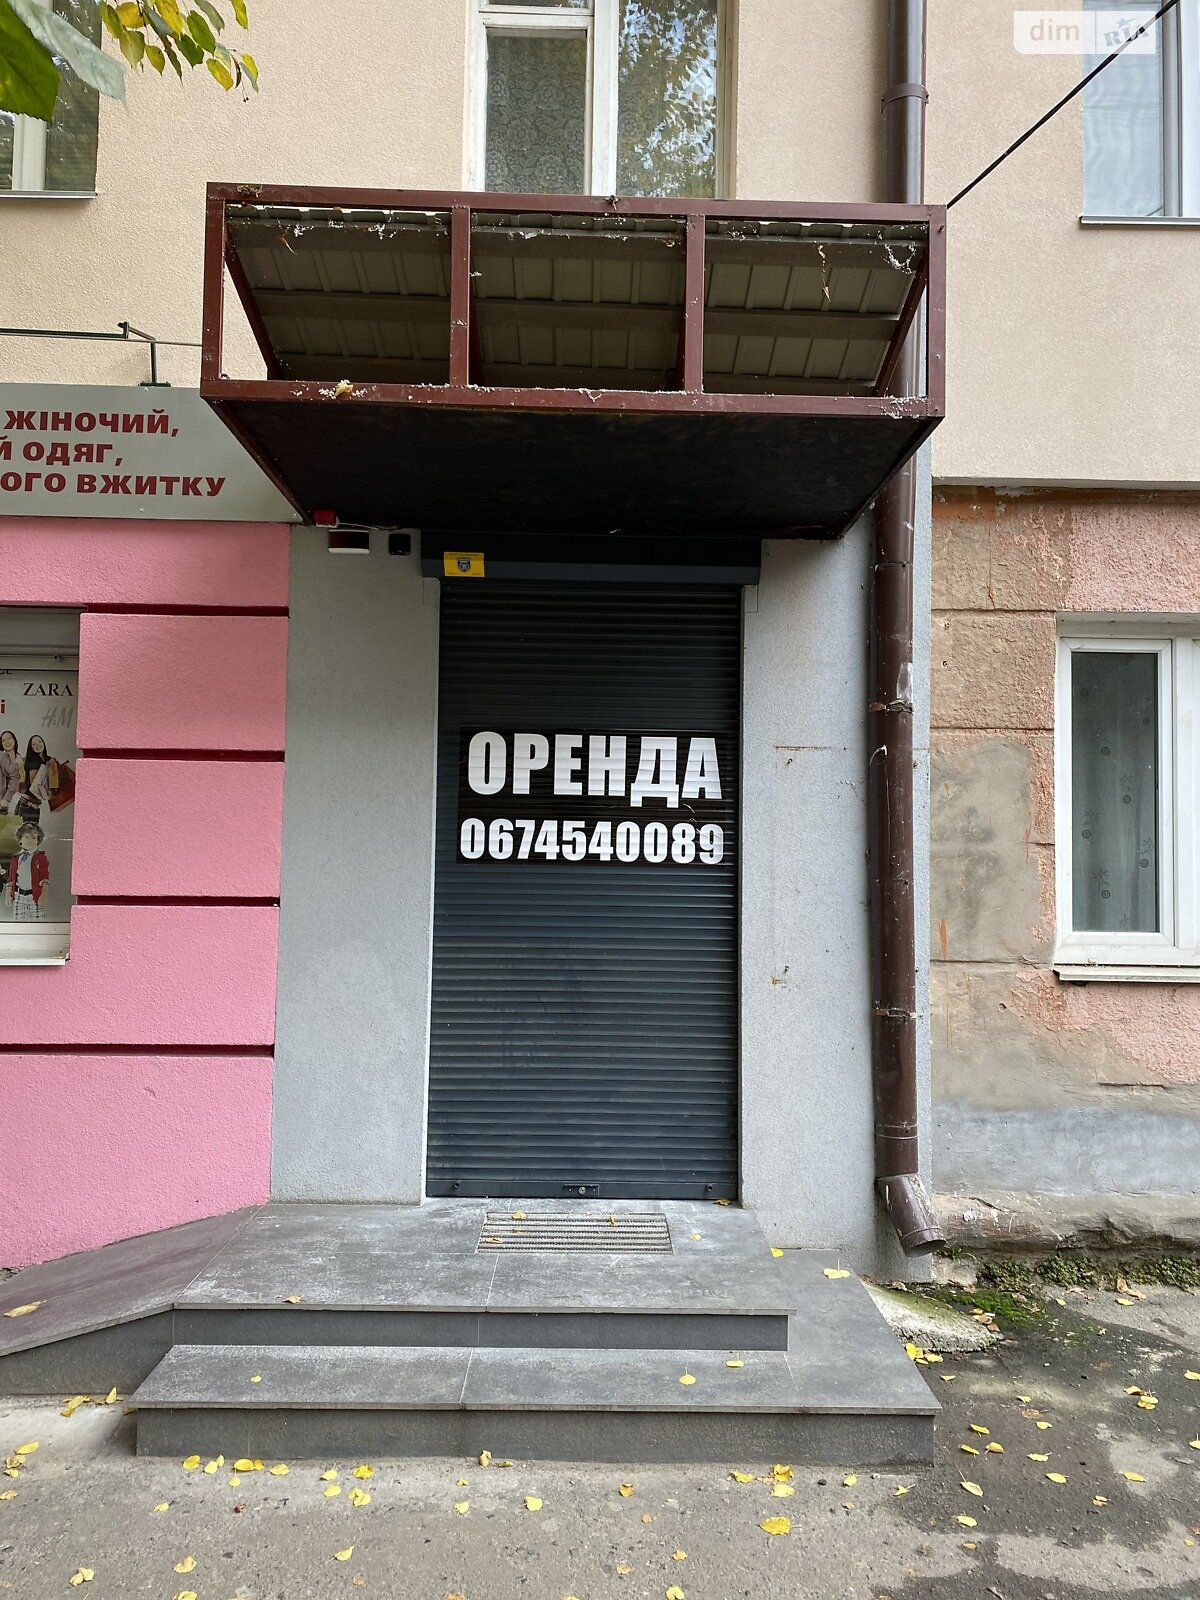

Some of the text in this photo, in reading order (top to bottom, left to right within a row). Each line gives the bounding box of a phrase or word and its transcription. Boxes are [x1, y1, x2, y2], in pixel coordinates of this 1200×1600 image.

[4, 408, 179, 437] ЖІНОЧИЙ,
[22, 441, 123, 467] ОДЯГ,
[76, 473, 226, 497] ВЖИТКУ
[23, 683, 74, 696] ZARA
[468, 731, 722, 808] ОРЕНДА
[460, 818, 724, 864] 0674540089
